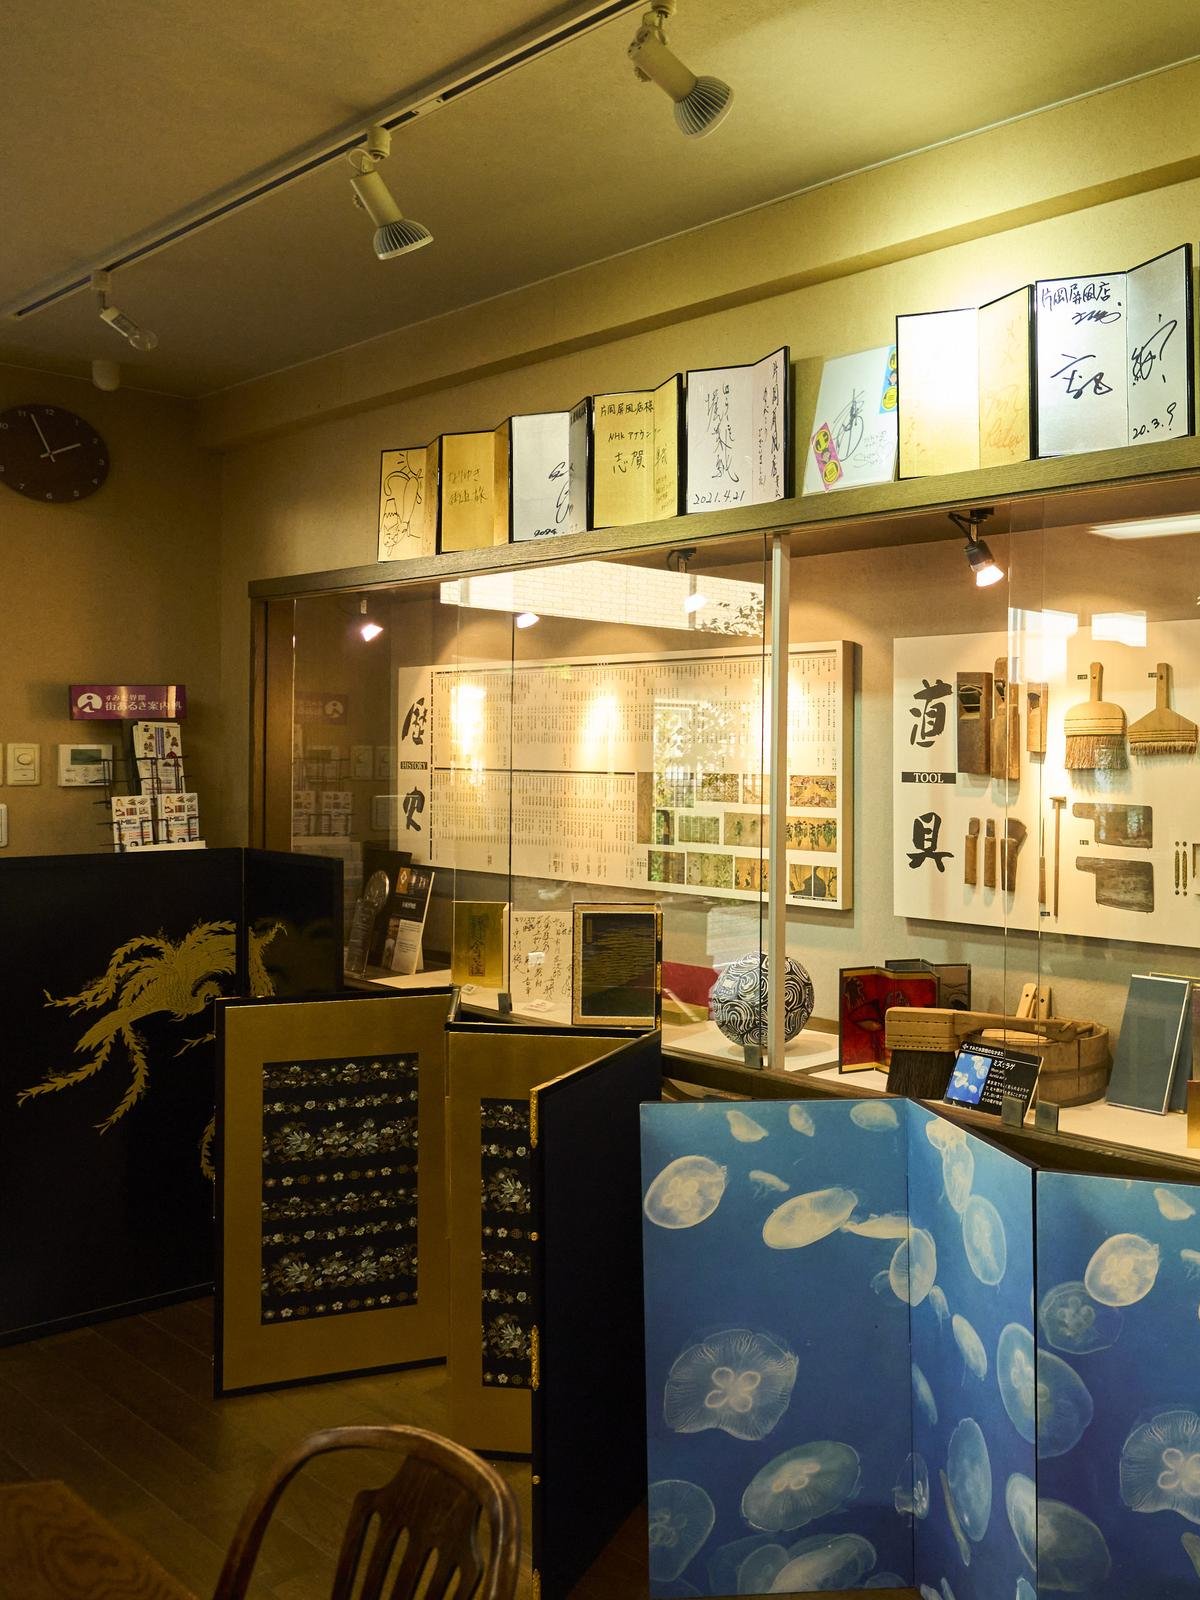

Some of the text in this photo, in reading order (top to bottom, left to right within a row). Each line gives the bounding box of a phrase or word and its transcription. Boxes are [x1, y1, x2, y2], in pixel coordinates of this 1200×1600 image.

[693, 490, 746, 505] 2021.4.21
[402, 761, 428, 770] HISTORY
[913, 772, 944, 784] TOOL
